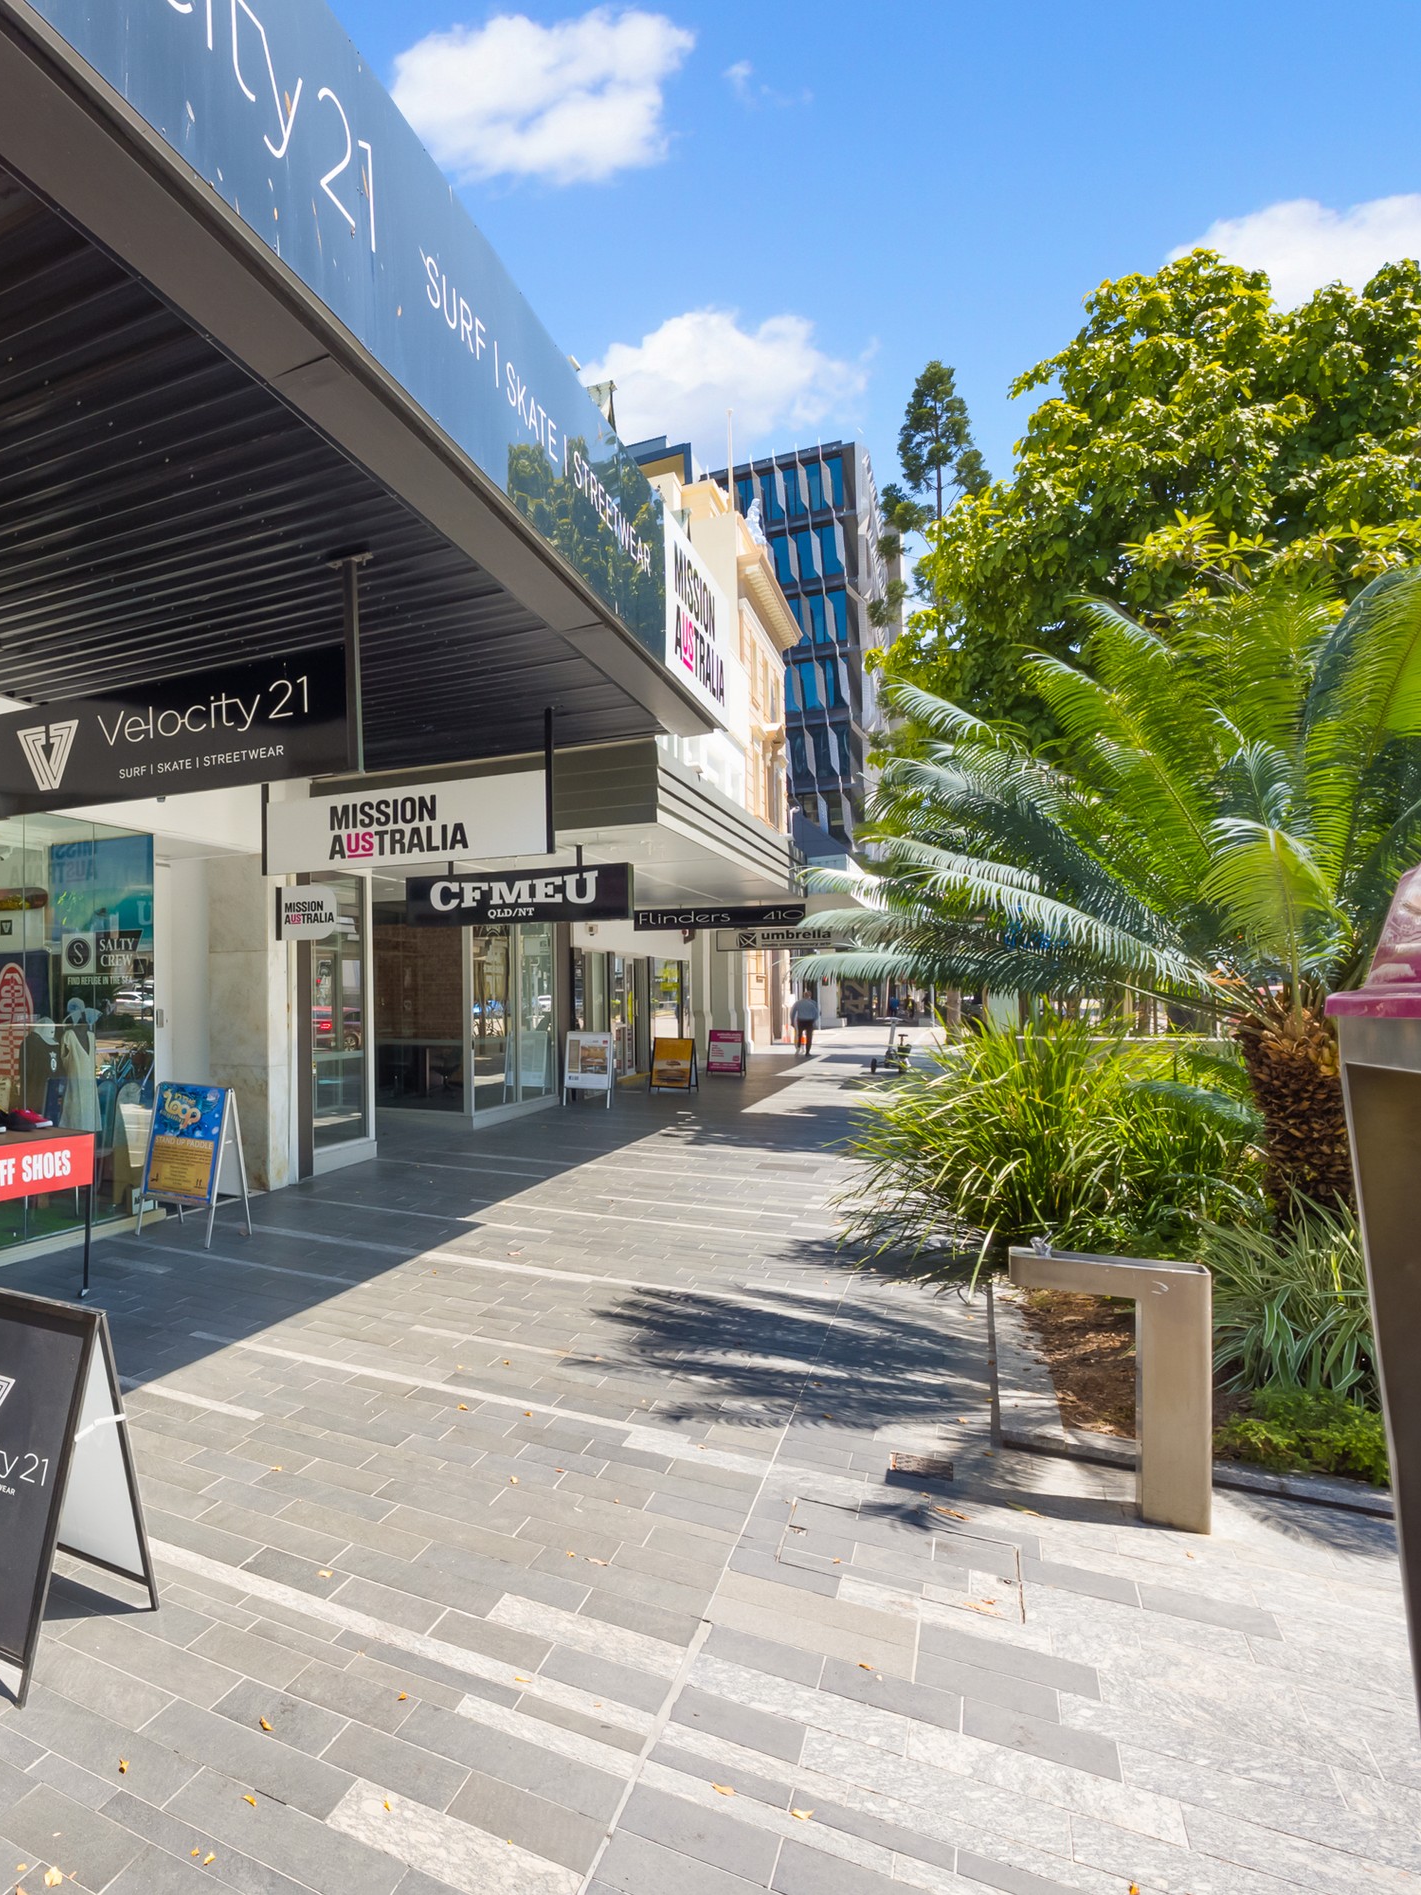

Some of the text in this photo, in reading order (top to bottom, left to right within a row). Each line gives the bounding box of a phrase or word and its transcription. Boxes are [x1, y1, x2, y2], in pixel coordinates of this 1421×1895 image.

[318, 87, 376, 253] 21
[425, 256, 487, 361] SURF
[506, 361, 559, 464] SKATE
[573, 450, 652, 578] STREETWEAR
[674, 540, 716, 642] MISSION
[674, 604, 725, 707] AUSTRALIA
[97, 675, 309, 746] Velocity 21
[119, 764, 147, 779] SURF
[157, 758, 192, 774] SKATE
[203, 745, 284, 767] STREETWEAR
[330, 794, 437, 831] MISSION
[329, 822, 469, 860] AUSTRALIA
[284, 900, 324, 913] MISSION
[430, 870, 598, 911] CFMEU
[284, 911, 334, 925] AUSTRALIA
[487, 907, 535, 919] QLD/NT
[639, 909, 804, 925] Flinders 410
[100, 938, 134, 952] SALTY
[761, 929, 831, 940] umbrella
[100, 954, 133, 967] CREW
[155, 1136, 213, 1150] STAND UP PADDLE
[22, 1149, 71, 1182] SHOES
[20, 1452, 49, 1487] 21
